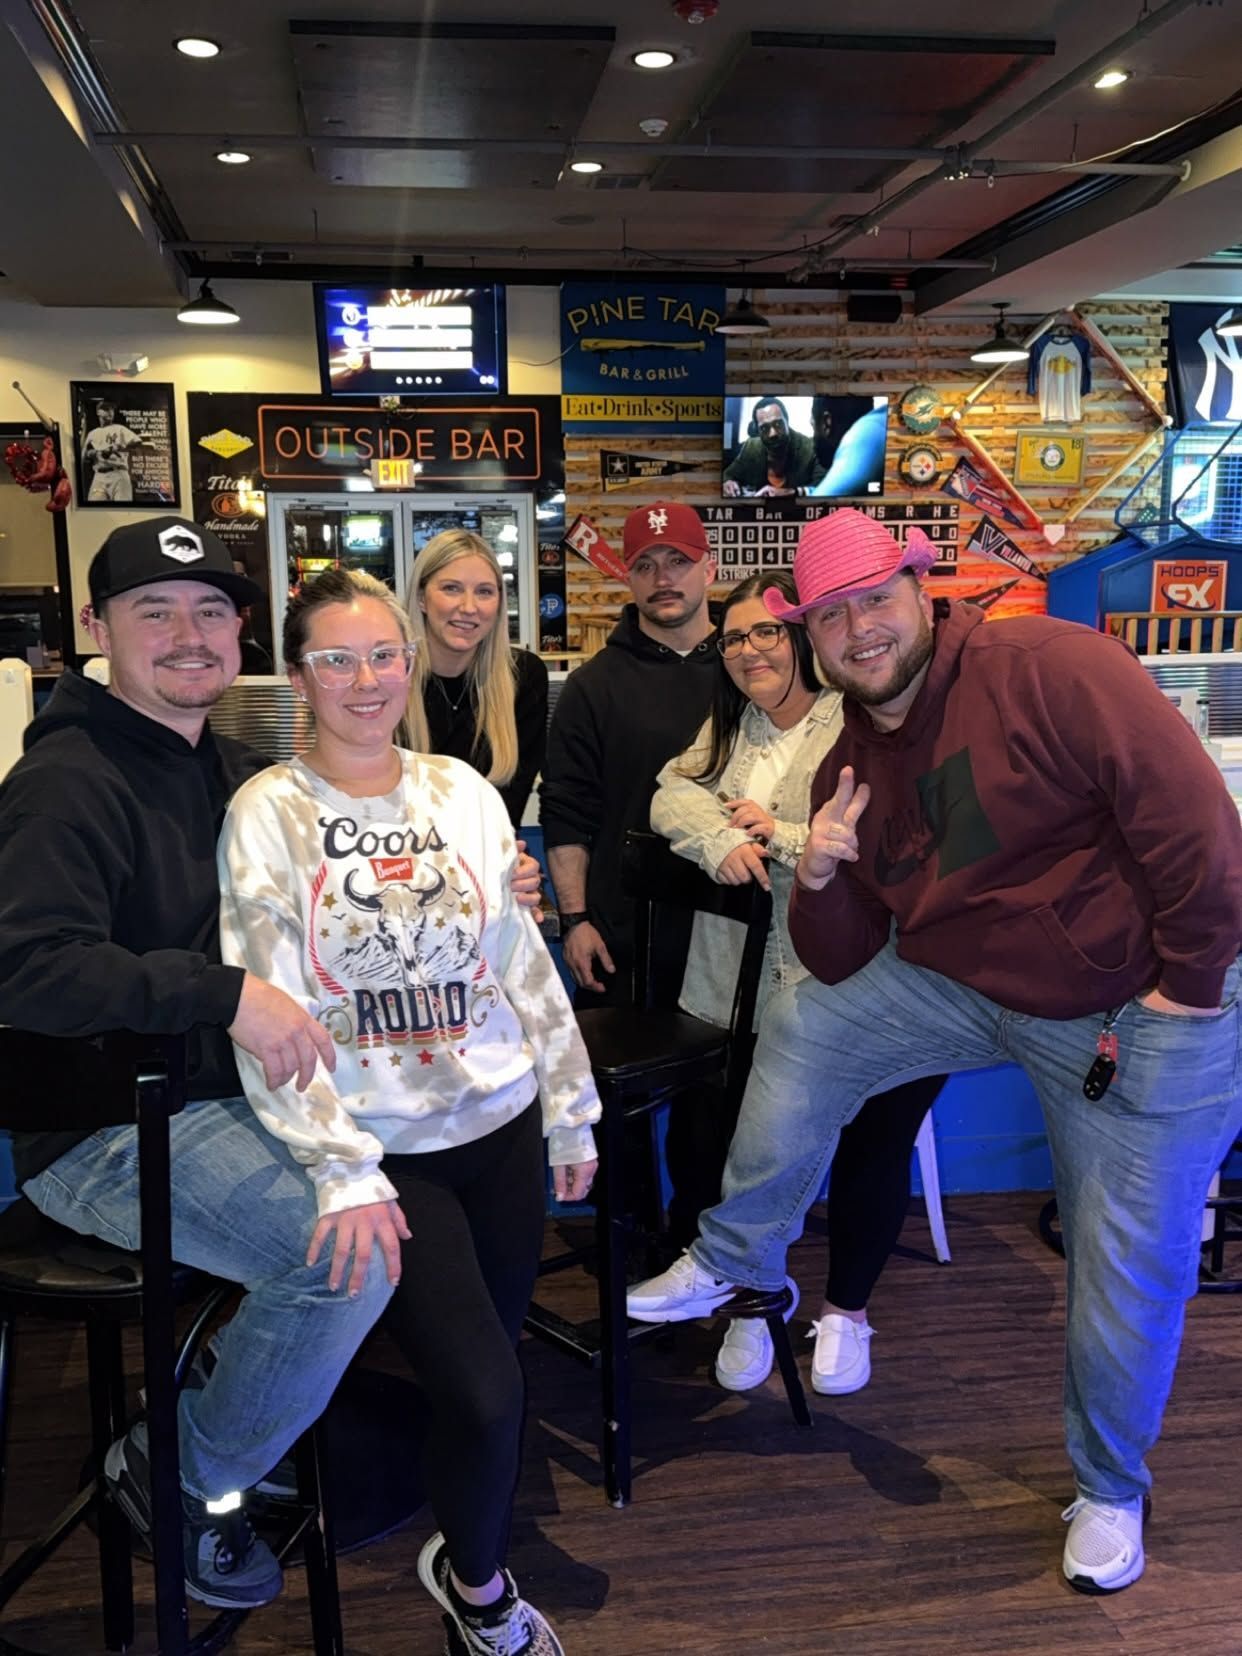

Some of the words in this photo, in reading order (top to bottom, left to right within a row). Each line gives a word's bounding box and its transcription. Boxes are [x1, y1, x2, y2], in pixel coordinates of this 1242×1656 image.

[567, 297, 645, 334] PINE
[657, 297, 720, 336] TAR
[600, 363, 630, 380] BAR
[633, 369, 643, 381] &
[646, 365, 689, 381] GRILL
[603, 398, 653, 417] Drink
[661, 399, 722, 422] Sports
[275, 427, 436, 460] OUTSIDE
[450, 428, 526, 460] BAR
[378, 461, 410, 485] EXIT
[706, 507, 733, 520] TAR
[805, 506, 824, 520] OF
[905, 504, 914, 518] R
[933, 504, 942, 518] H
[949, 504, 959, 518] E
[204, 519, 260, 532] Handmade
[568, 521, 599, 556] R
[979, 523, 1008, 554] V
[1161, 565, 1219, 577] HOOPS
[318, 816, 448, 859] Coors
